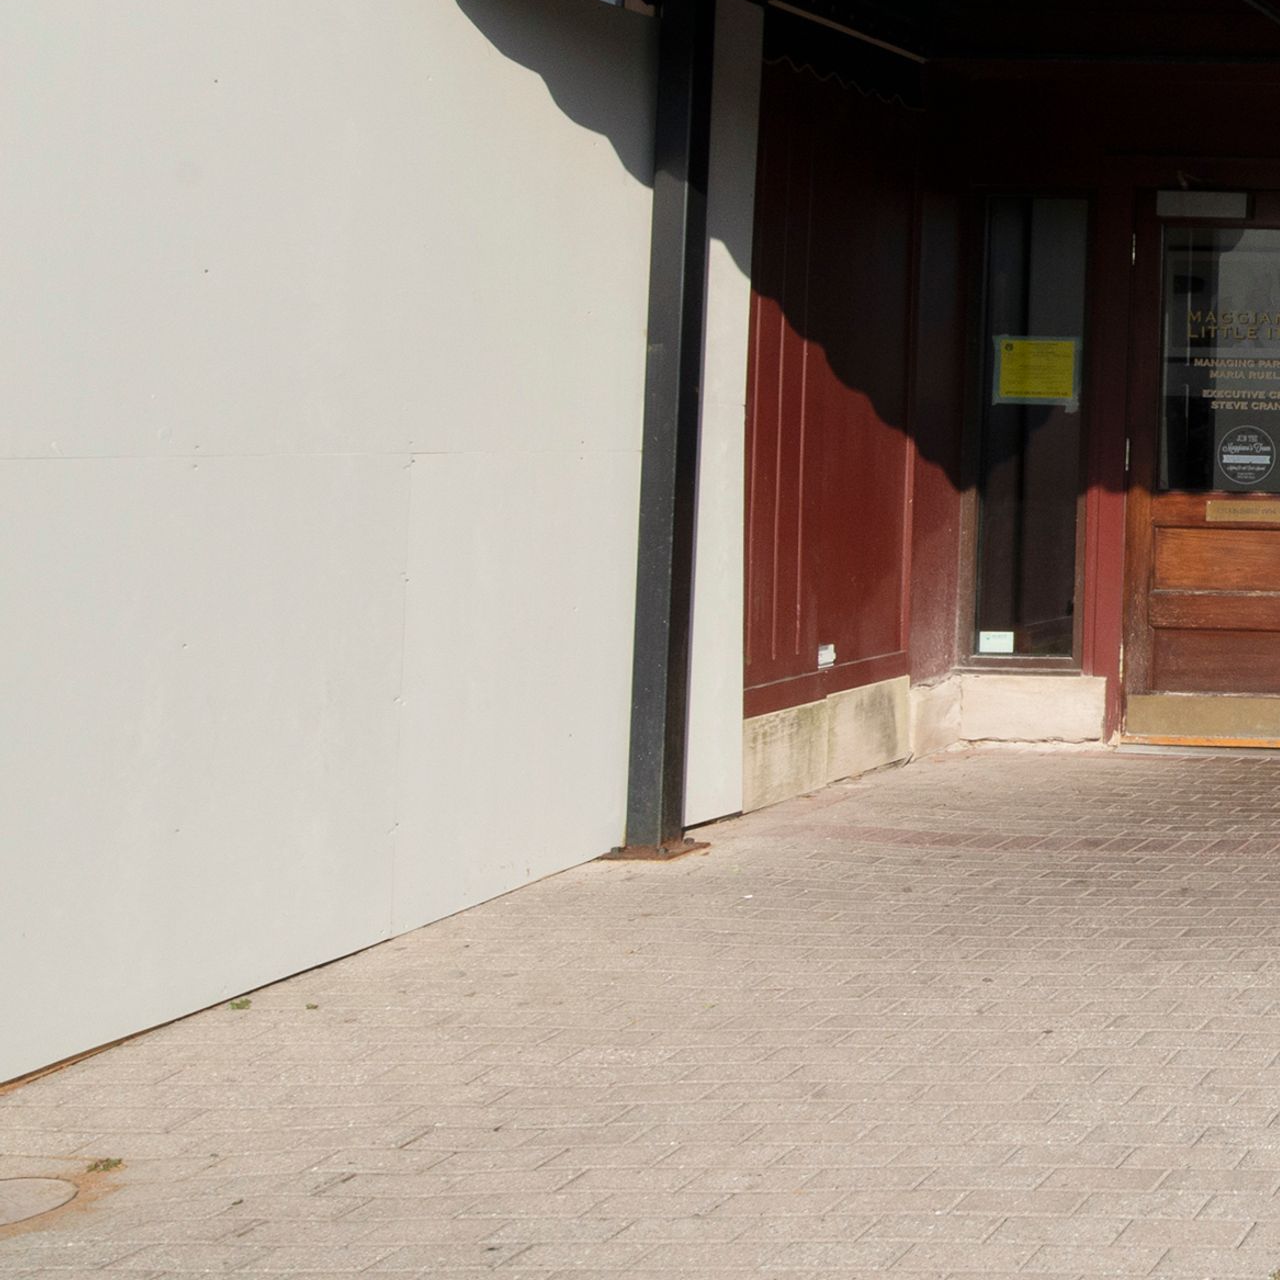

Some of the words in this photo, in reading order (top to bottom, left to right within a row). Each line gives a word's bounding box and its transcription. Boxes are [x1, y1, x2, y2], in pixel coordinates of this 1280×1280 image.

[1187, 325, 1258, 339] LITTLE
[1193, 358, 1256, 368] MANAGING
[1209, 370, 1246, 379] MARIA
[1202, 389, 1266, 399] EXECUTIVE
[1210, 401, 1249, 410] STEVE
